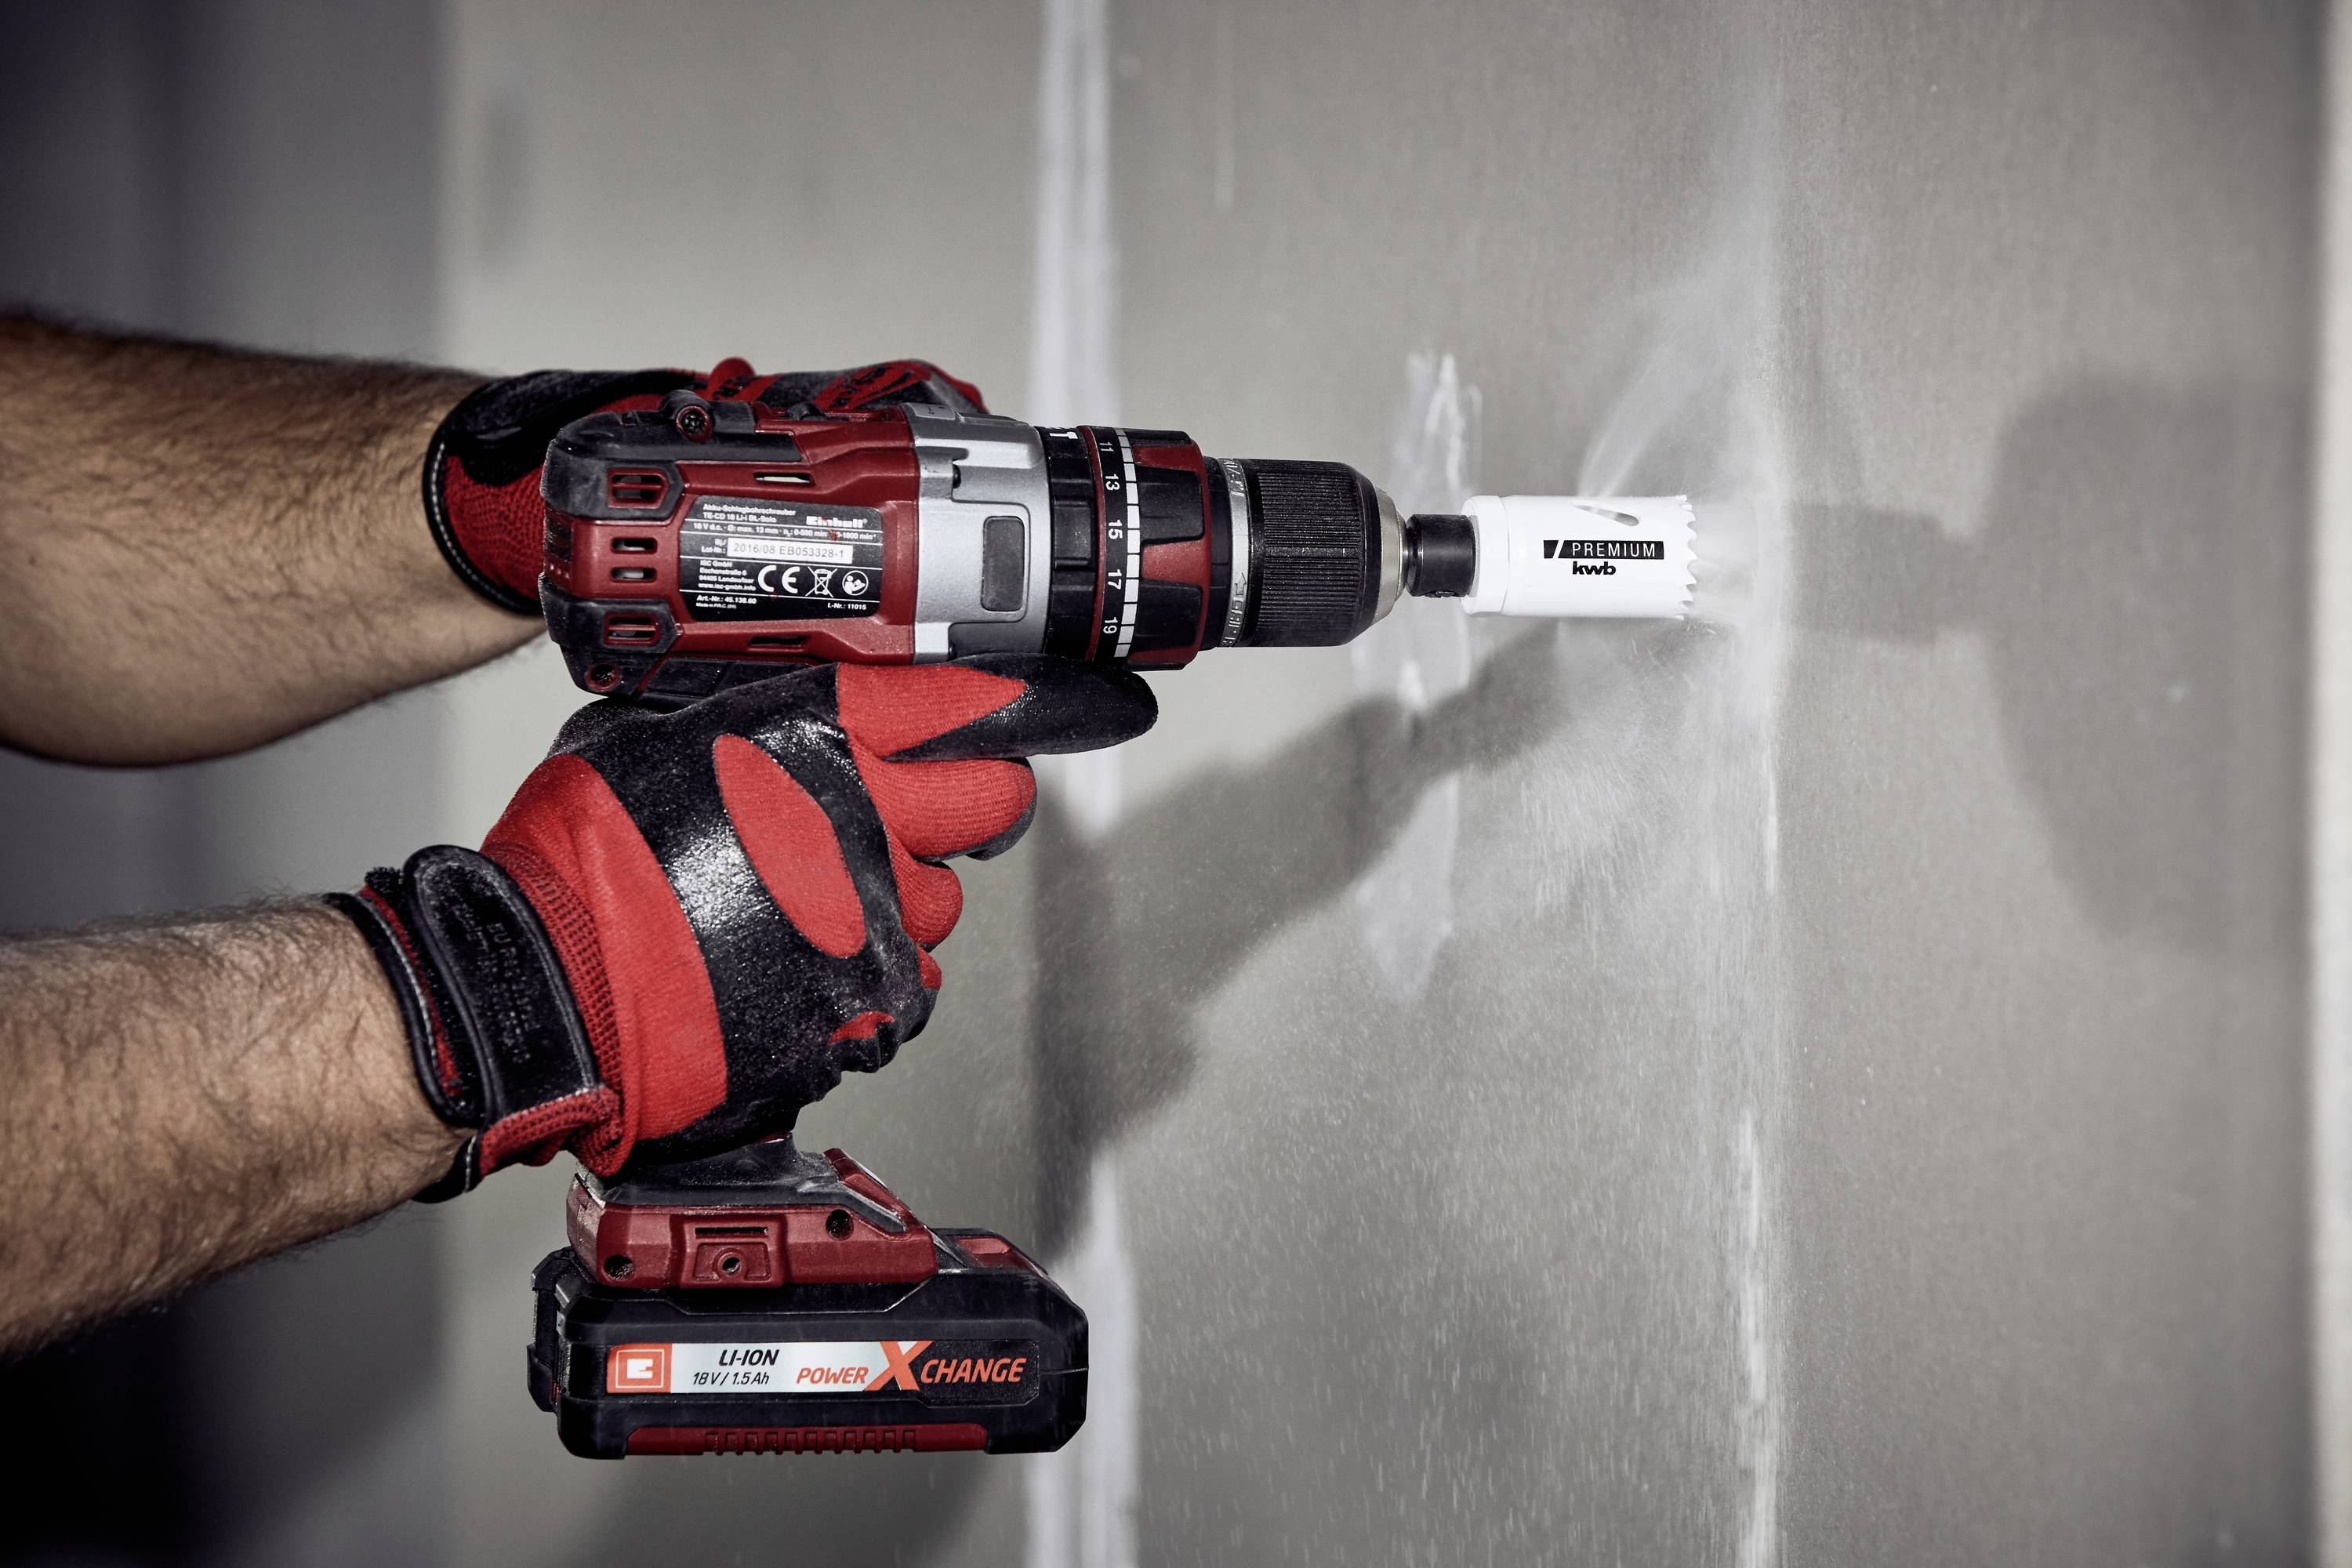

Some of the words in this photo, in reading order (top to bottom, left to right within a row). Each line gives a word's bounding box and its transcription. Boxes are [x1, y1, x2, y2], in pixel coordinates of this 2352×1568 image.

[1099, 441, 1114, 452] 11
[1105, 473, 1120, 491] 13
[702, 511, 726, 521] TE-CD
[1108, 519, 1123, 540] 15
[733, 543, 776, 554] 2016/08
[779, 545, 844, 559] EB053328-1
[1572, 542, 1655, 557] PREMIUM
[1572, 561, 1617, 575] kwb
[1107, 568, 1122, 590] 17
[1102, 616, 1118, 635] 19
[718, 1349, 780, 1367] LI-ION
[796, 1367, 869, 1385] POWER
